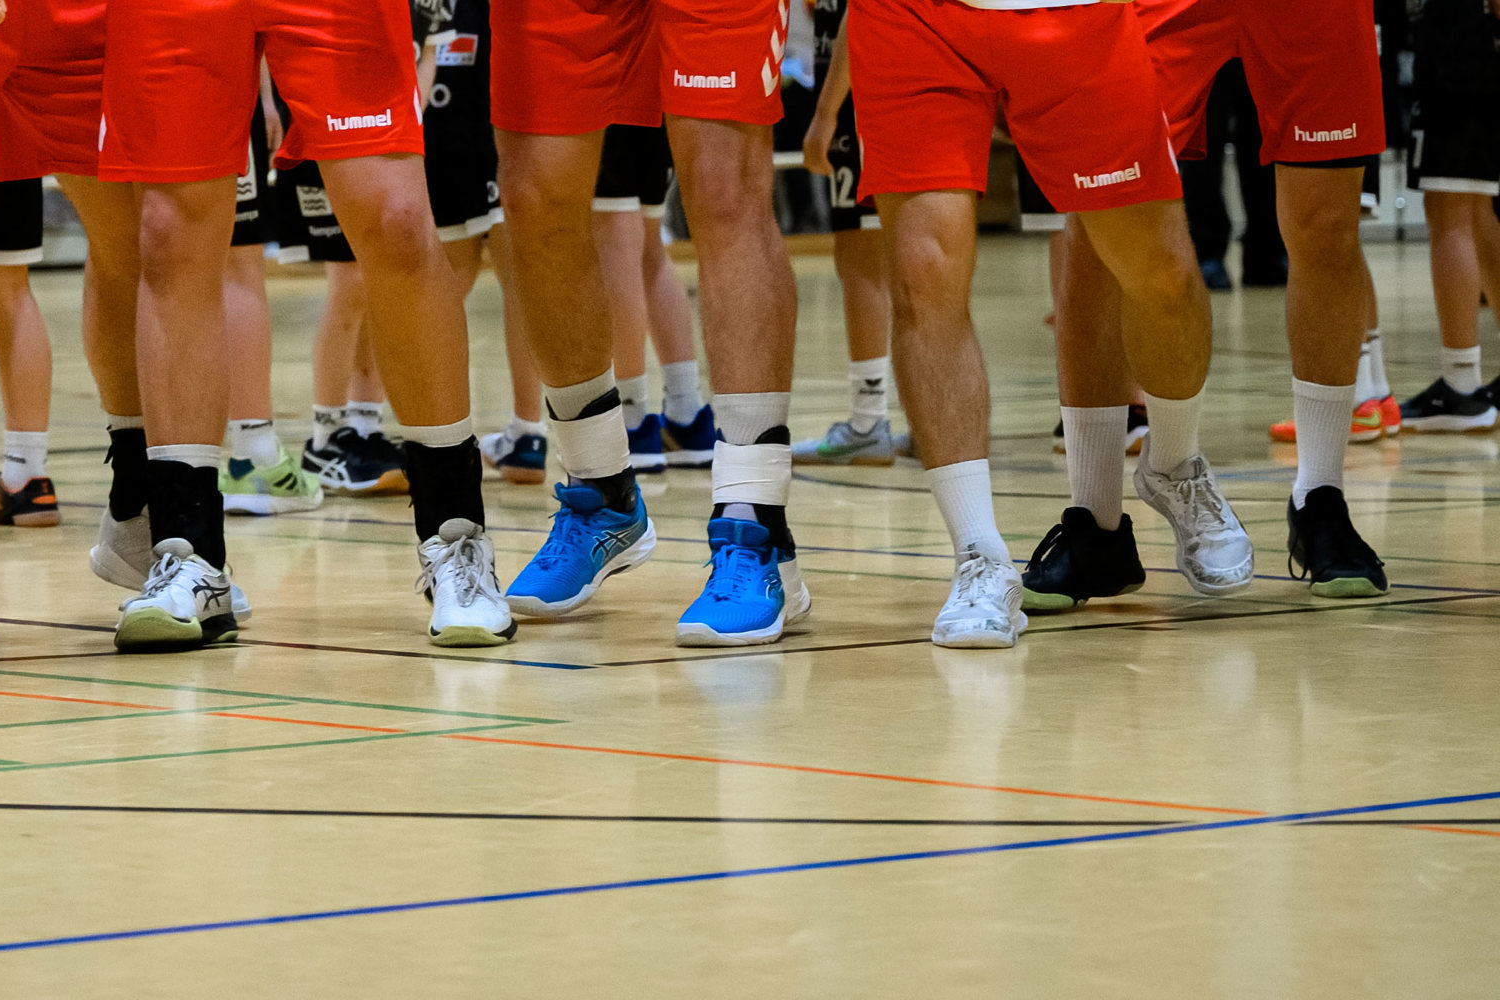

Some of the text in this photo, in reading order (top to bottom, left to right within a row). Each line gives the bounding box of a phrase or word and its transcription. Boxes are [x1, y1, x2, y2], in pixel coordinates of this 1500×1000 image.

[674, 69, 736, 88] hummel
[327, 109, 392, 132] hummel
[1294, 122, 1356, 141] hummel
[1073, 161, 1141, 189] hummel
